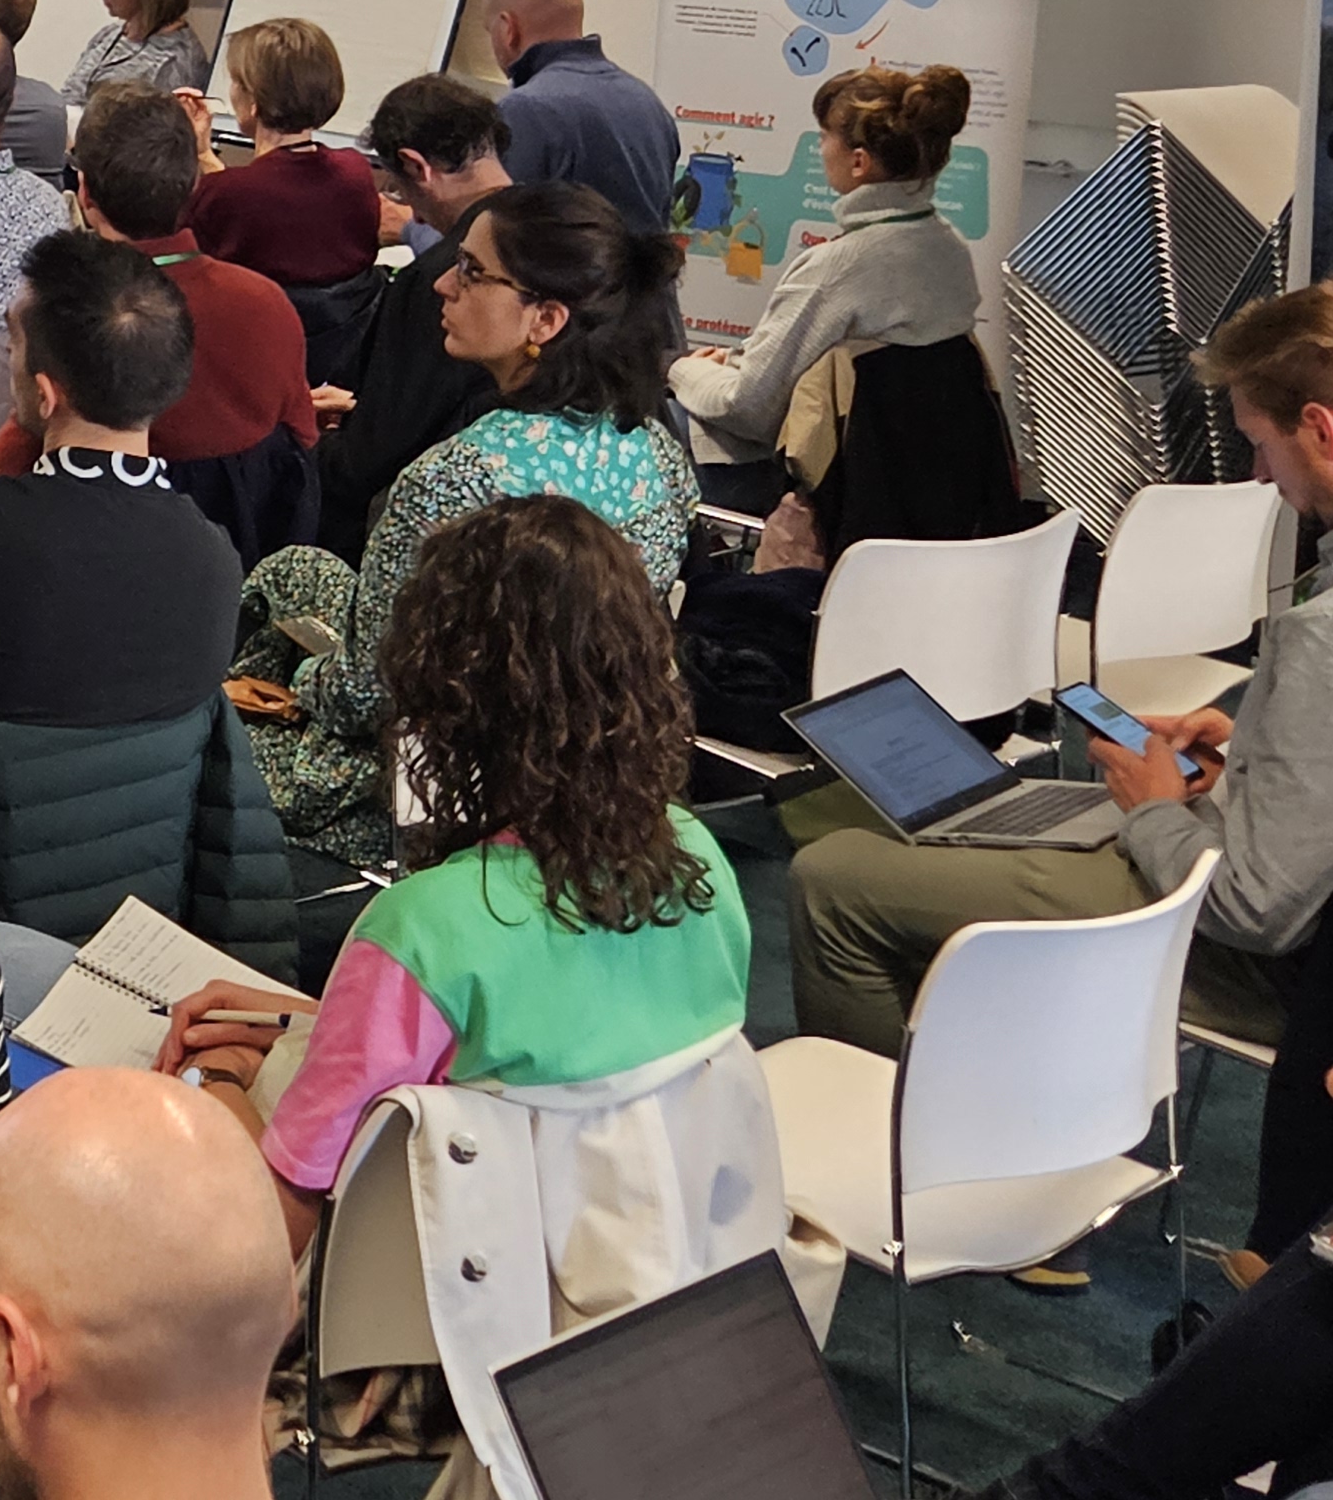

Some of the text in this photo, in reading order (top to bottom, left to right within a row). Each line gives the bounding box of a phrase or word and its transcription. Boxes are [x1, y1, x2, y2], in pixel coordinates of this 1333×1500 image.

[675, 105, 775, 128] Comment agir ?
[696, 318, 751, 336] protéger
